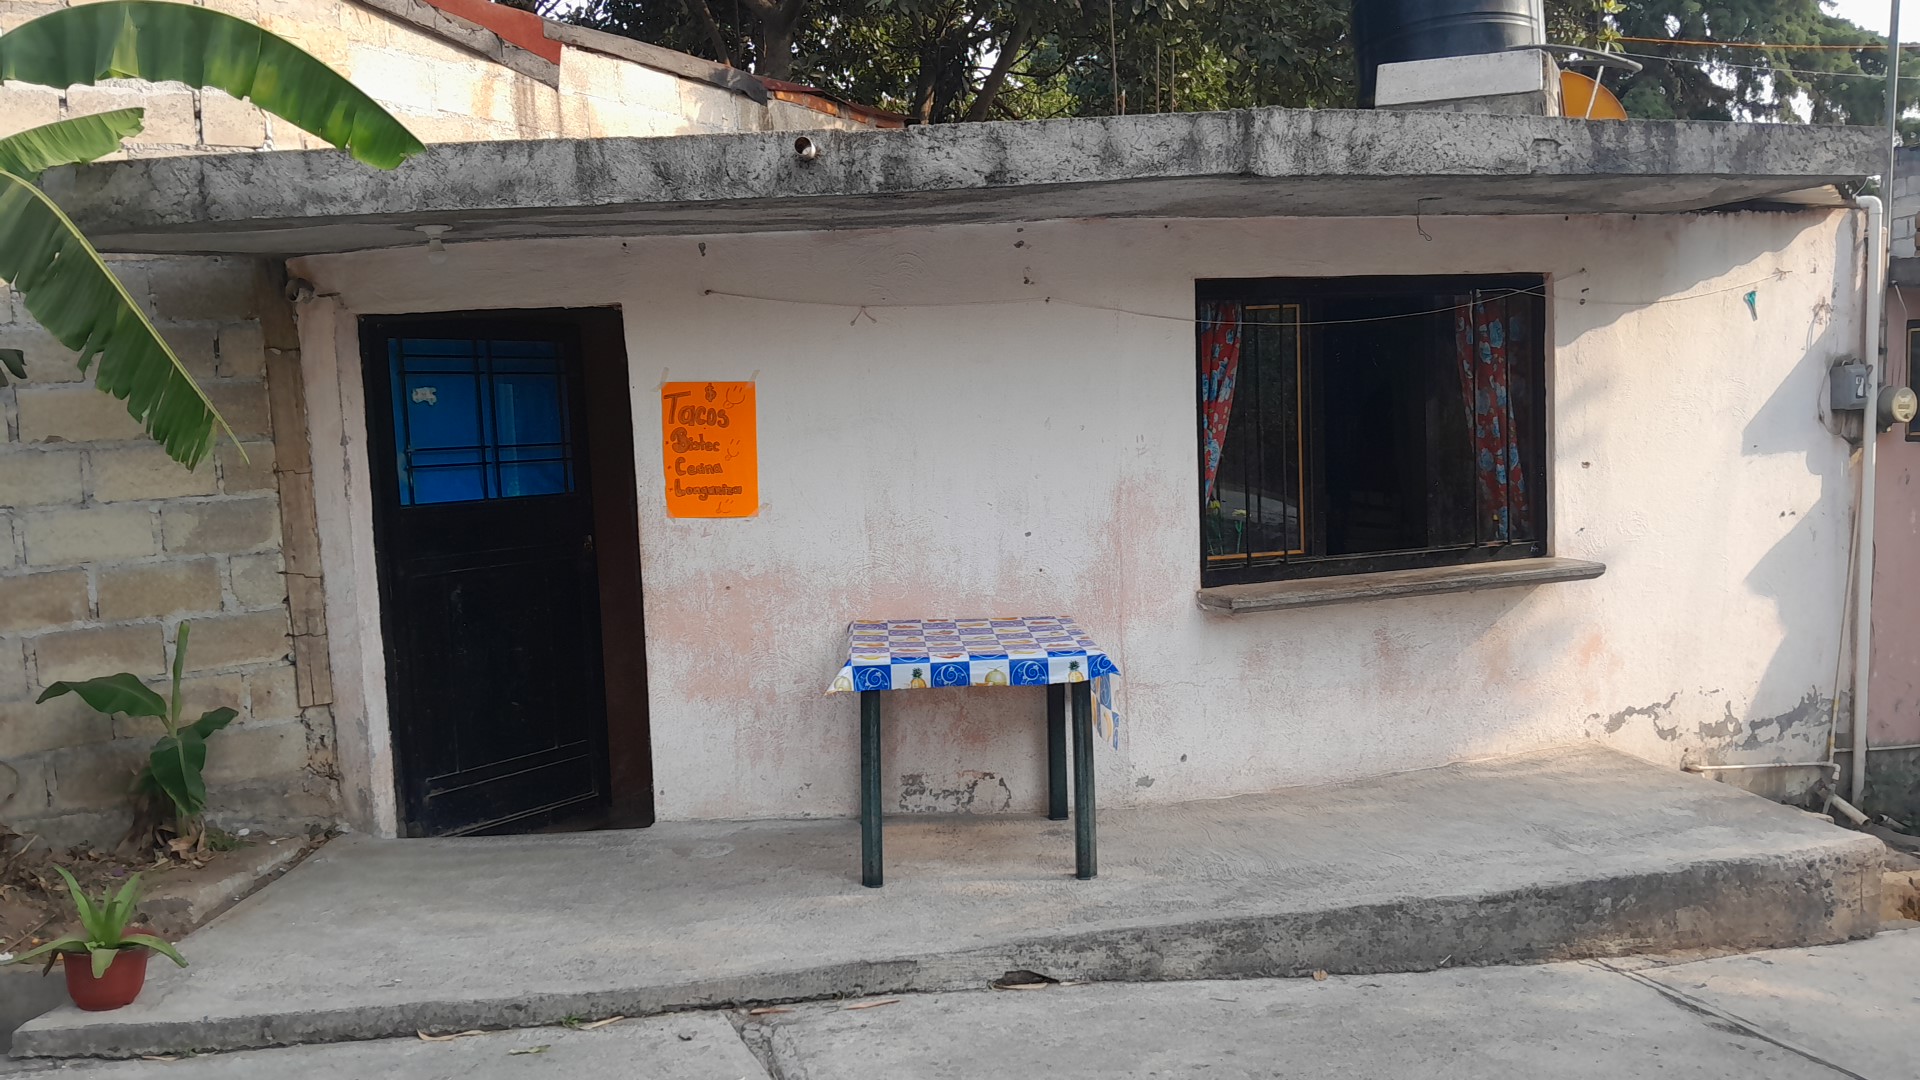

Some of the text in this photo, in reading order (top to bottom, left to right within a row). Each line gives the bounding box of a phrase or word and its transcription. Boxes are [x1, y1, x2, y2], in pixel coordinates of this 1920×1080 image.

[664, 391, 730, 428] Tacos
[675, 456, 723, 476] Cecina
[674, 479, 742, 500] Longaniza
